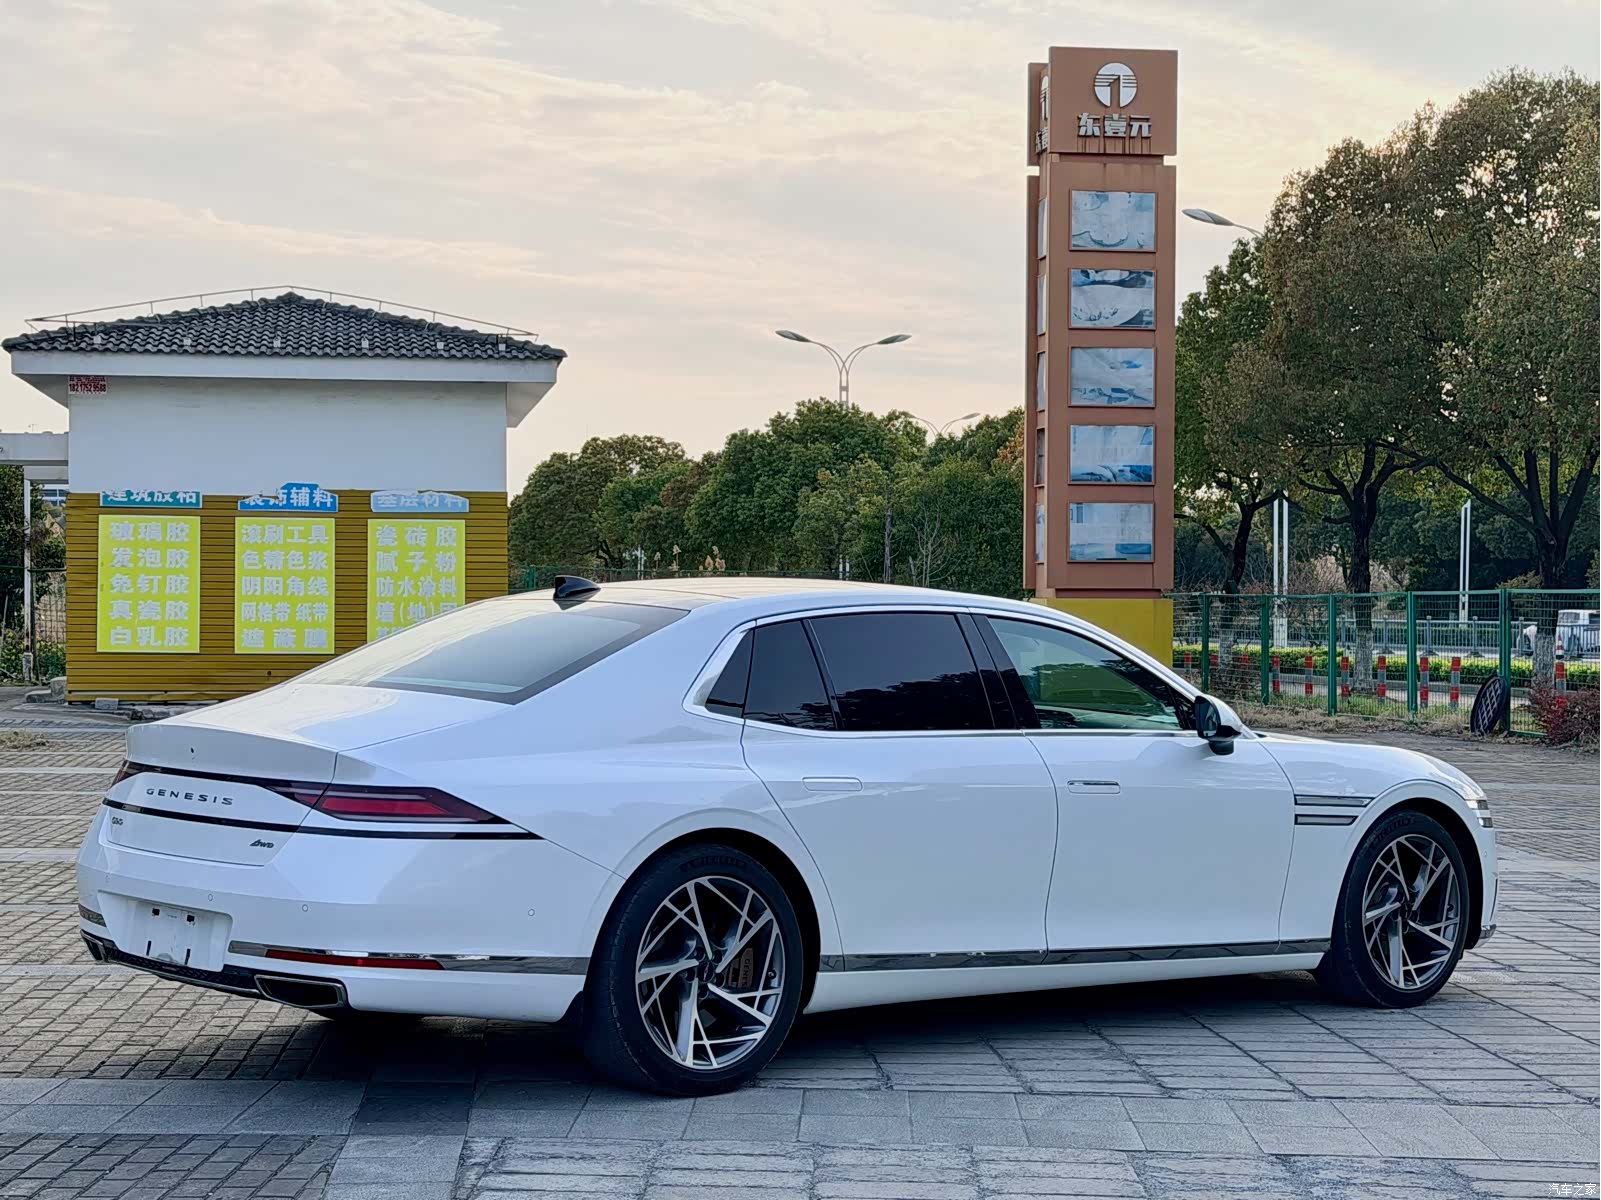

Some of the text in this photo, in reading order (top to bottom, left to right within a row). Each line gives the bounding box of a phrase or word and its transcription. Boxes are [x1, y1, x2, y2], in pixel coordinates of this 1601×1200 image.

[1078, 112, 1152, 137] 东壹元
[242, 524, 329, 545] 滚刷工具
[376, 525, 457, 547] 瓷砖胶
[110, 547, 189, 569] 发泡胶
[376, 551, 457, 573] 腻子粉
[110, 573, 189, 595] 免钉胶
[242, 576, 329, 597] 阴阳角线
[376, 576, 457, 598] 防水涂料
[110, 625, 189, 647] 白乳胶
[146, 788, 233, 806] GENESIS
